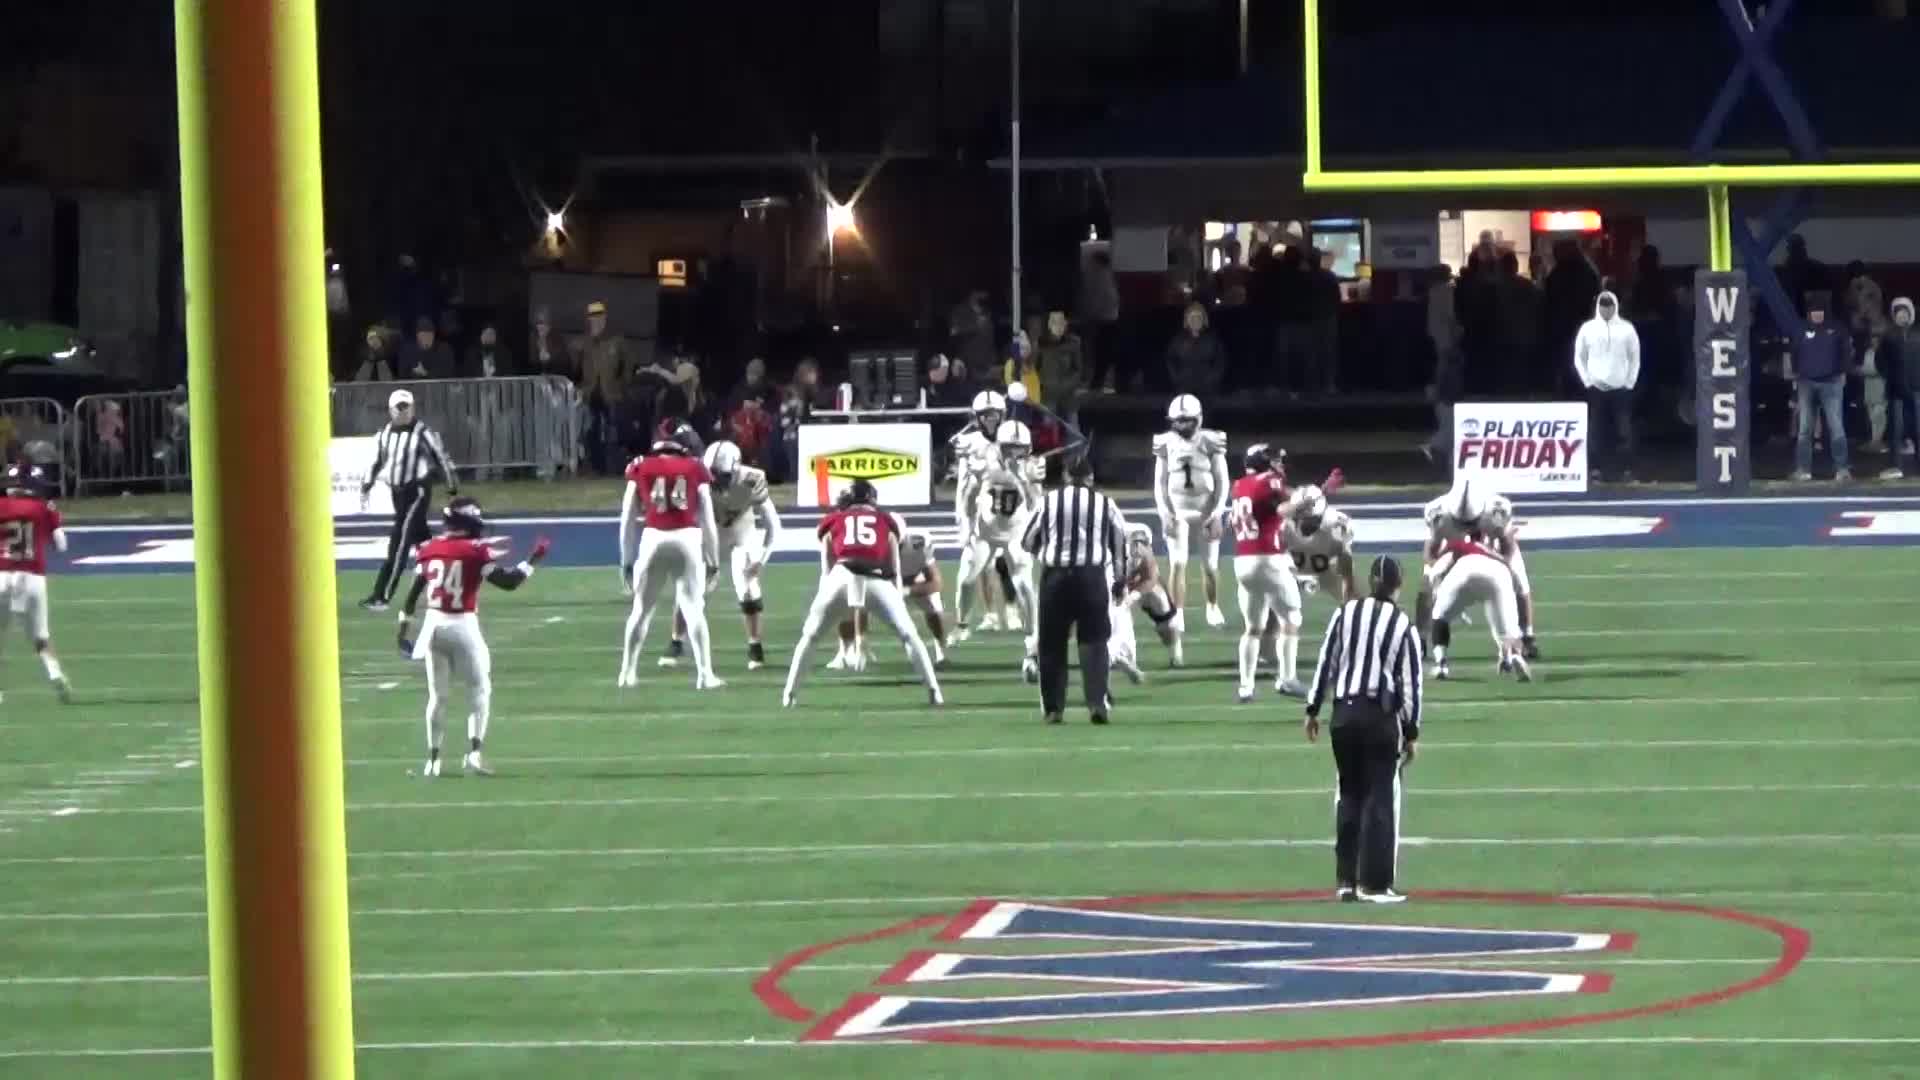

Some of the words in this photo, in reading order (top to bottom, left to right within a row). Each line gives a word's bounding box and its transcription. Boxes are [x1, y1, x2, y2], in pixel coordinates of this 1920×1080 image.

[1705, 287, 1738, 483] WEST
[1483, 420, 1579, 438] PLAYOFF
[1457, 438, 1584, 470] FRIDAY
[651, 475, 688, 513] 44
[843, 515, 877, 545] 15
[427, 558, 464, 608] 24
